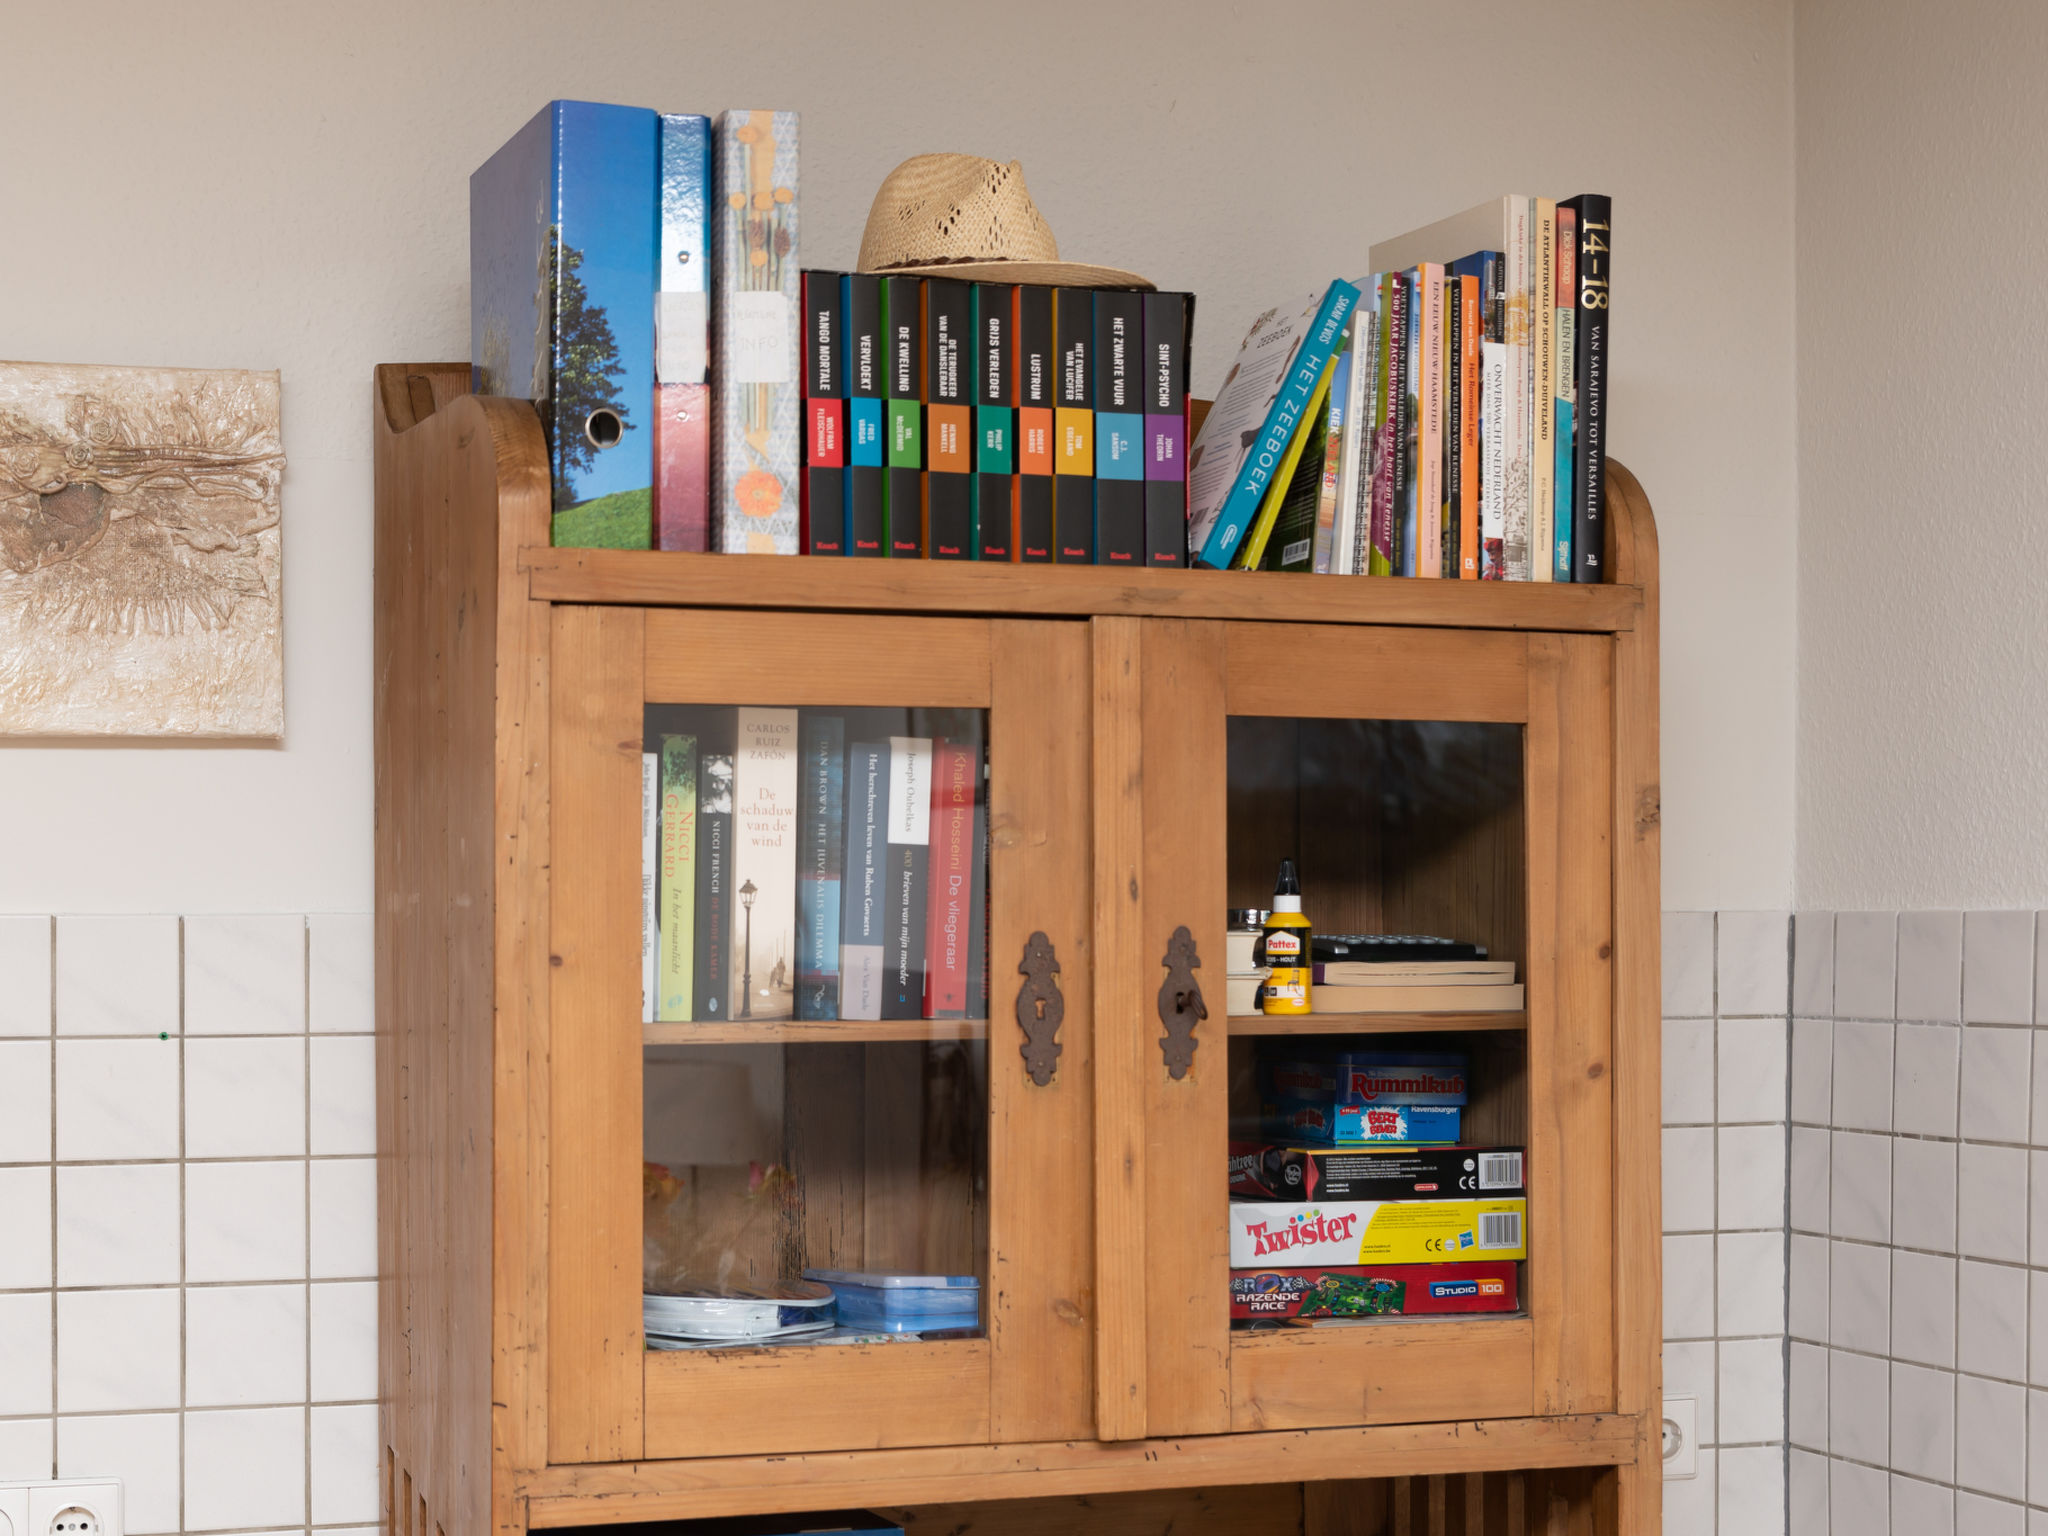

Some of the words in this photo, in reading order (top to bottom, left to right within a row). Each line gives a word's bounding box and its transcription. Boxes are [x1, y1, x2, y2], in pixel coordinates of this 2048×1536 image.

[1543, 219, 1550, 233] DE
[1563, 231, 1573, 249] Dick
[1542, 235, 1550, 309] ATLANTIKWALL
[1562, 251, 1572, 284] Schoop
[1392, 294, 1400, 310] 500
[1432, 281, 1440, 301] EEN
[1330, 294, 1350, 323] SARAH
[1398, 285, 1408, 347] VOETSTAPPEN
[1432, 304, 1440, 333] EEUW
[1452, 288, 1460, 350] VOETSTAPPEN
[1542, 312, 1549, 325] OP
[818, 310, 830, 343] TANGO
[898, 326, 910, 340] DE
[938, 315, 948, 331] VAN
[989, 318, 1000, 346] GRIJS
[1113, 317, 1124, 336] HET
[1318, 317, 1340, 345] DEVOS
[1391, 313, 1400, 339] JAAR
[1561, 309, 1571, 339] HALEN
[938, 333, 948, 342] DE
[948, 339, 957, 349] DE
[1075, 342, 1084, 355] HET
[1561, 341, 1571, 353] EN
[1590, 326, 1600, 351] VAN
[819, 345, 830, 390] MORTALE
[860, 335, 872, 390] VERVLOEKT
[898, 342, 910, 391] KWELLING
[1065, 350, 1074, 363] VAN
[1113, 338, 1125, 377] ZWARTE
[1398, 350, 1407, 360] IN
[1452, 353, 1460, 363] IN
[938, 343, 948, 396] DANSLERAAR
[948, 350, 957, 397] TERUGKEER
[989, 349, 1000, 398] VERLEDEN
[1030, 353, 1041, 400] LUSTRUM
[1065, 365, 1074, 400] LUCIFER
[1075, 357, 1084, 400] EVANGELIE
[1297, 353, 1322, 397] HET
[1388, 342, 1399, 419] JACOBUSKERK
[1398, 363, 1406, 380] HET
[1452, 366, 1460, 383] HET
[1561, 355, 1571, 398] BRENGEN
[1114, 378, 1125, 406] VUUR
[1541, 327, 1549, 441] SCHOUWEN-DUIVELAND
[1588, 355, 1600, 417] SARAJEVO
[1396, 383, 1406, 431] VERLEDEN
[1430, 372, 1439, 434] HAAMSTEDE
[1451, 385, 1459, 433] VERLEDEN
[1468, 380, 1476, 421] Romeinse
[1493, 363, 1503, 447] ONVERWACHT
[827, 416, 835, 450] WOLFRAM
[858, 418, 866, 444] VARGAS
[867, 423, 875, 440] FRED
[896, 415, 904, 451] McDERMID
[1329, 407, 1342, 434] KIEK
[1387, 423, 1396, 432] in
[1588, 420, 1598, 446] TOT
[940, 423, 948, 453] MANKELL
[949, 423, 957, 454] HENNING
[995, 429, 1003, 451] PHILIP
[1036, 428, 1044, 454] ROBERT
[1066, 427, 1074, 456] EGELAND
[1075, 435, 1083, 449] TOM
[1111, 432, 1119, 460] SANSOM
[1156, 434, 1164, 461] THEORIN
[1164, 437, 1173, 459] JOHAN
[1244, 397, 1300, 496] ZEEBOEK
[1386, 436, 1396, 452] het
[1396, 432, 1404, 450] VAN
[1451, 434, 1459, 452] VAN
[1466, 423, 1475, 447] Leger
[1386, 456, 1395, 477] hart
[1395, 452, 1403, 491] RENESSE
[1451, 455, 1459, 494] RENESSE
[1385, 481, 1393, 499] van
[1492, 449, 1503, 520] NEDERLAND
[1587, 450, 1598, 520] VERSAILLES
[1383, 503, 1392, 541] Renesse
[746, 723, 791, 734] CARLOS
[755, 737, 781, 747] RUIZ
[750, 748, 786, 760] ZAFÓN
[819, 741, 828, 766] DAN
[868, 754, 878, 771] Het
[904, 752, 917, 784] Joseph
[952, 752, 967, 802] Khaled
[759, 787, 776, 801] De
[818, 770, 828, 815] BROWN
[866, 772, 878, 823] herschreven
[740, 803, 793, 817] schaduw
[904, 787, 916, 832] Oubelkas
[663, 794, 680, 878] GERRARD
[678, 811, 694, 862] NICCI
[711, 820, 721, 850] NICCI
[746, 820, 769, 832] van
[772, 818, 788, 832] de
[817, 823, 827, 843] HET
[865, 825, 876, 848] leven
[949, 807, 964, 870] Hosseini
[751, 833, 783, 848] wind
[865, 849, 874, 865] van
[903, 849, 913, 868] 400
[710, 853, 720, 894] FRENCH
[815, 848, 827, 909] JUVENALIS
[864, 867, 875, 896] Ruben
[902, 870, 914, 905] brieven
[948, 875, 962, 896] De
[672, 888, 682, 900] In
[710, 897, 719, 910] DE
[671, 903, 681, 920] het
[863, 898, 873, 937] Govaerts
[901, 907, 911, 924] van
[710, 913, 719, 941] RODE
[814, 913, 825, 968] DILEMMA
[898, 926, 910, 948] mijn
[944, 900, 961, 971] vliegeraar
[670, 921, 681, 975] maanlicht
[1267, 939, 1297, 949] Pattex
[709, 944, 718, 980] KAMER
[899, 950, 910, 986] moeder
[1352, 1072, 1465, 1101] Rummikub
[1368, 1110, 1400, 1125] BERT
[1411, 1105, 1458, 1115] Ravensburger
[1370, 1123, 1398, 1136] BEVER
[1246, 1212, 1357, 1257] Twister
[1236, 1293, 1300, 1303] RAZENDE
[1435, 1287, 1476, 1296] STUDIO
[1481, 1284, 1502, 1293] 100
[1250, 1302, 1286, 1311] RACE
